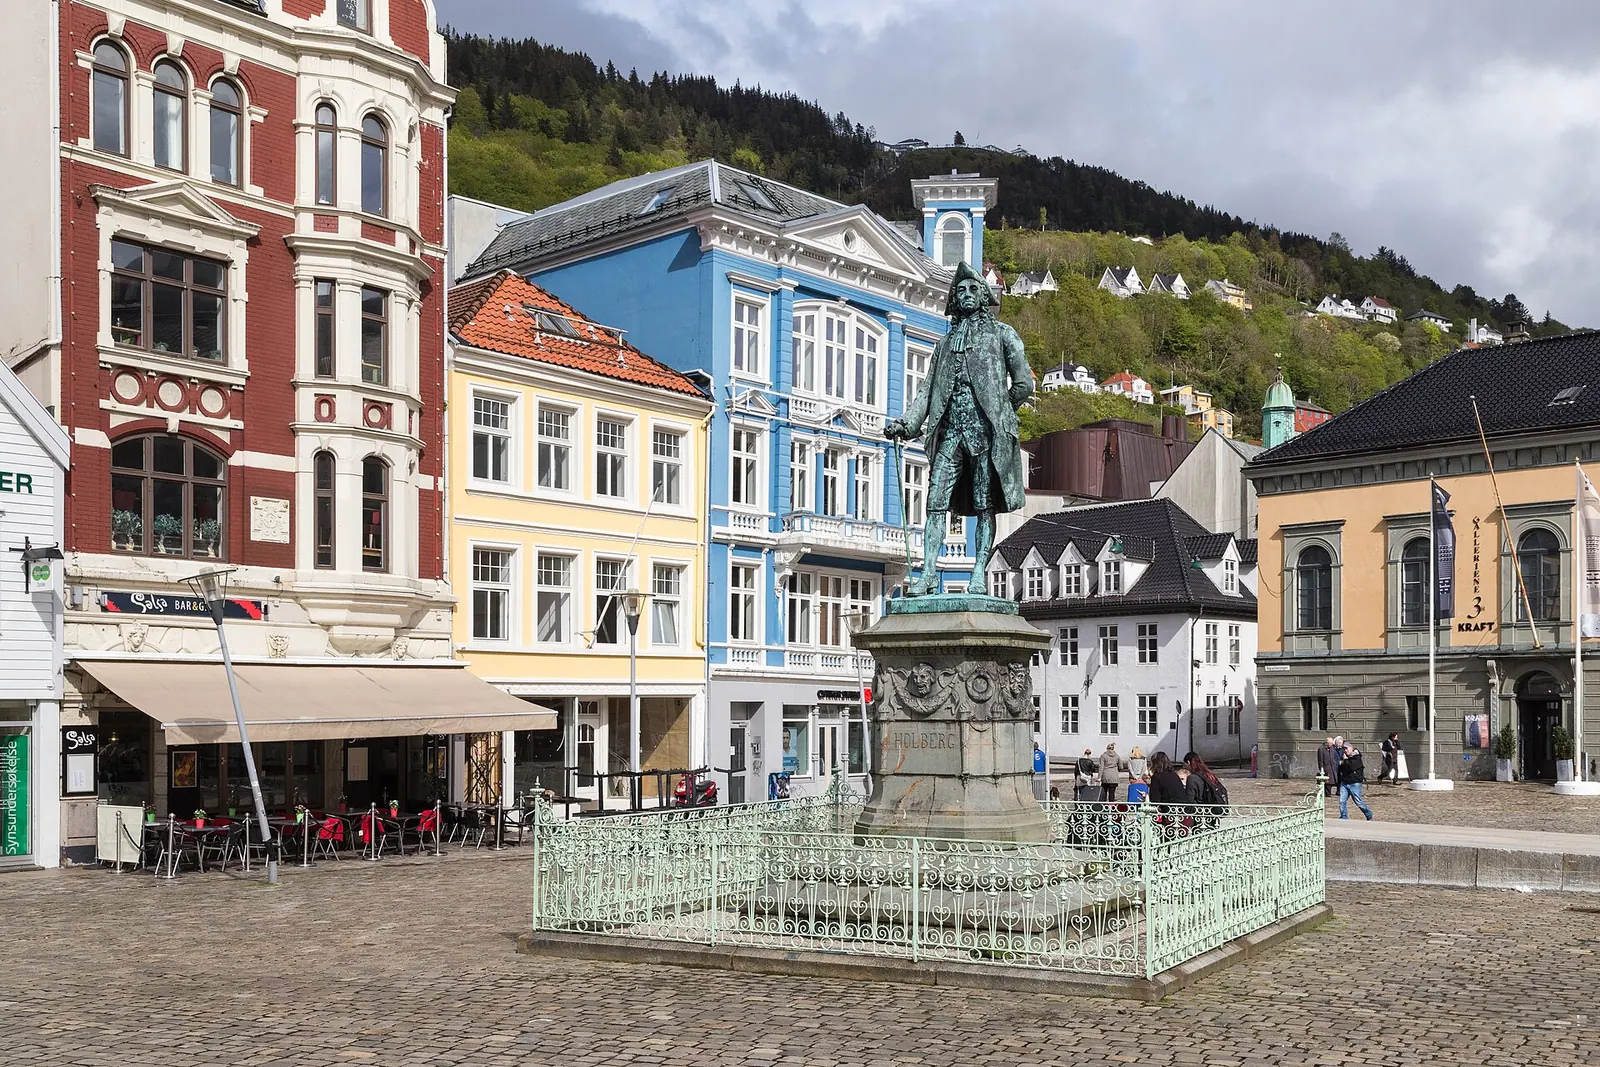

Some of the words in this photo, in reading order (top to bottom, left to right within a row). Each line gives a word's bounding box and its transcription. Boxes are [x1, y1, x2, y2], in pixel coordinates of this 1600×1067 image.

[0, 471, 33, 494] ER
[1472, 515, 1480, 593] GALLERIENE
[130, 592, 168, 614] Salsa
[1466, 596, 1482, 619] 3
[1457, 622, 1495, 632] KRAFT
[66, 730, 96, 750] Salsa
[894, 732, 955, 749] HOLBERG
[6, 741, 19, 855] Synsundersøkelse
